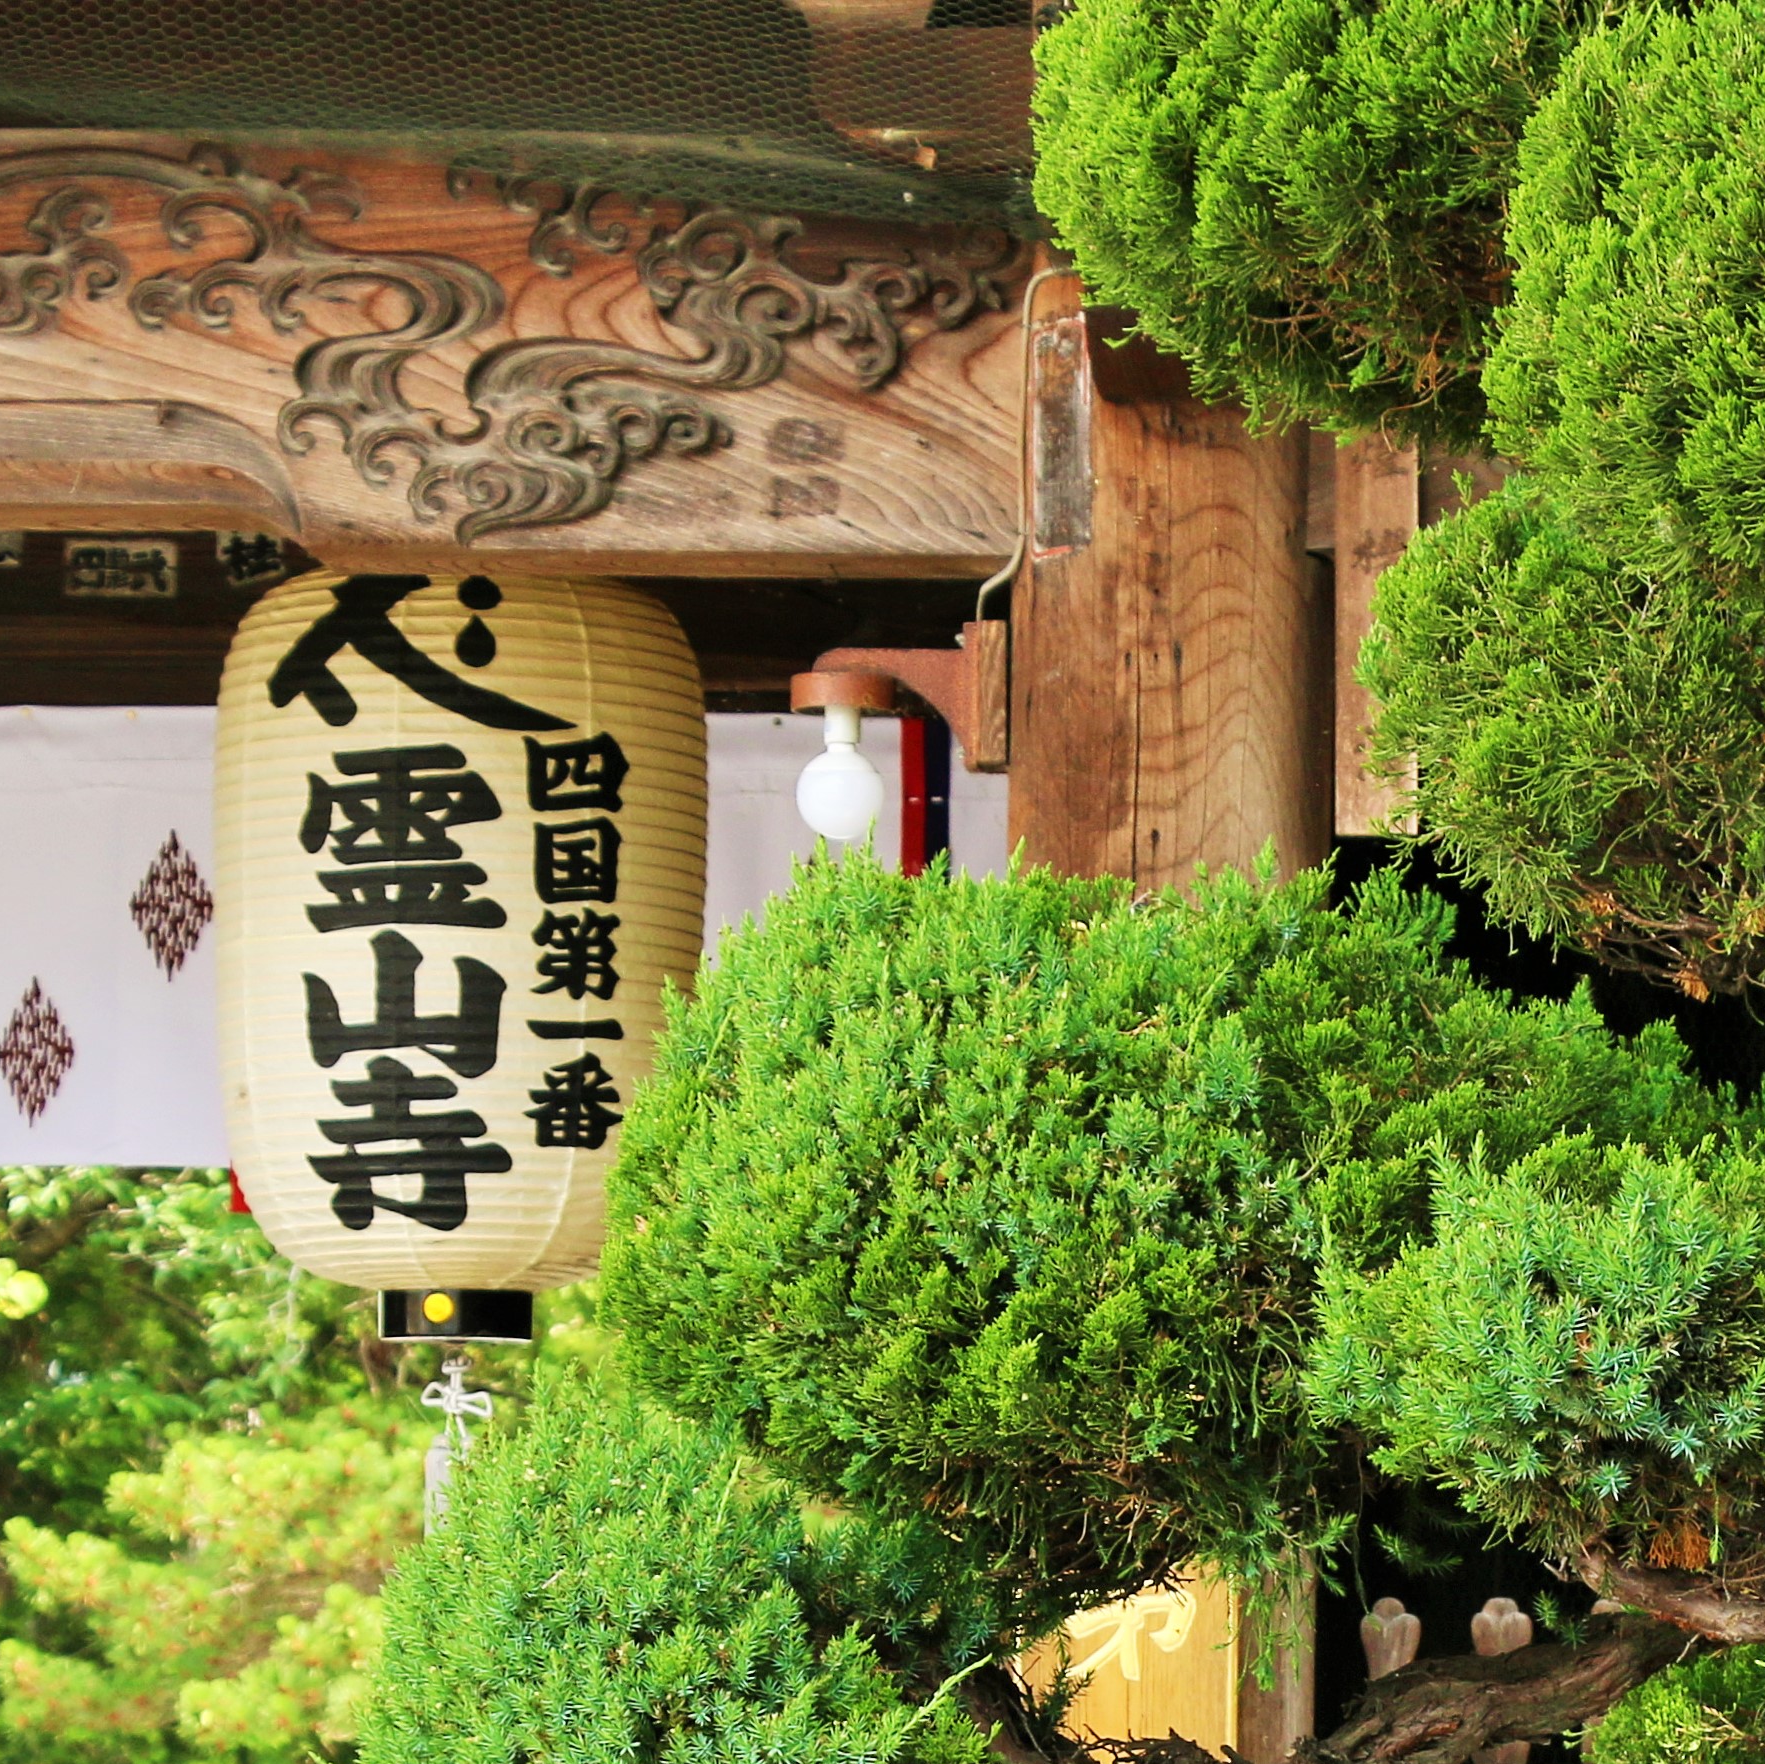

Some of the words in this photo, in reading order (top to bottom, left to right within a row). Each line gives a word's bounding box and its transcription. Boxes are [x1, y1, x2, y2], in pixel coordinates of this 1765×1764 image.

[299, 743, 513, 1231] 霊山寺
[522, 732, 631, 1151] 四国第一番
